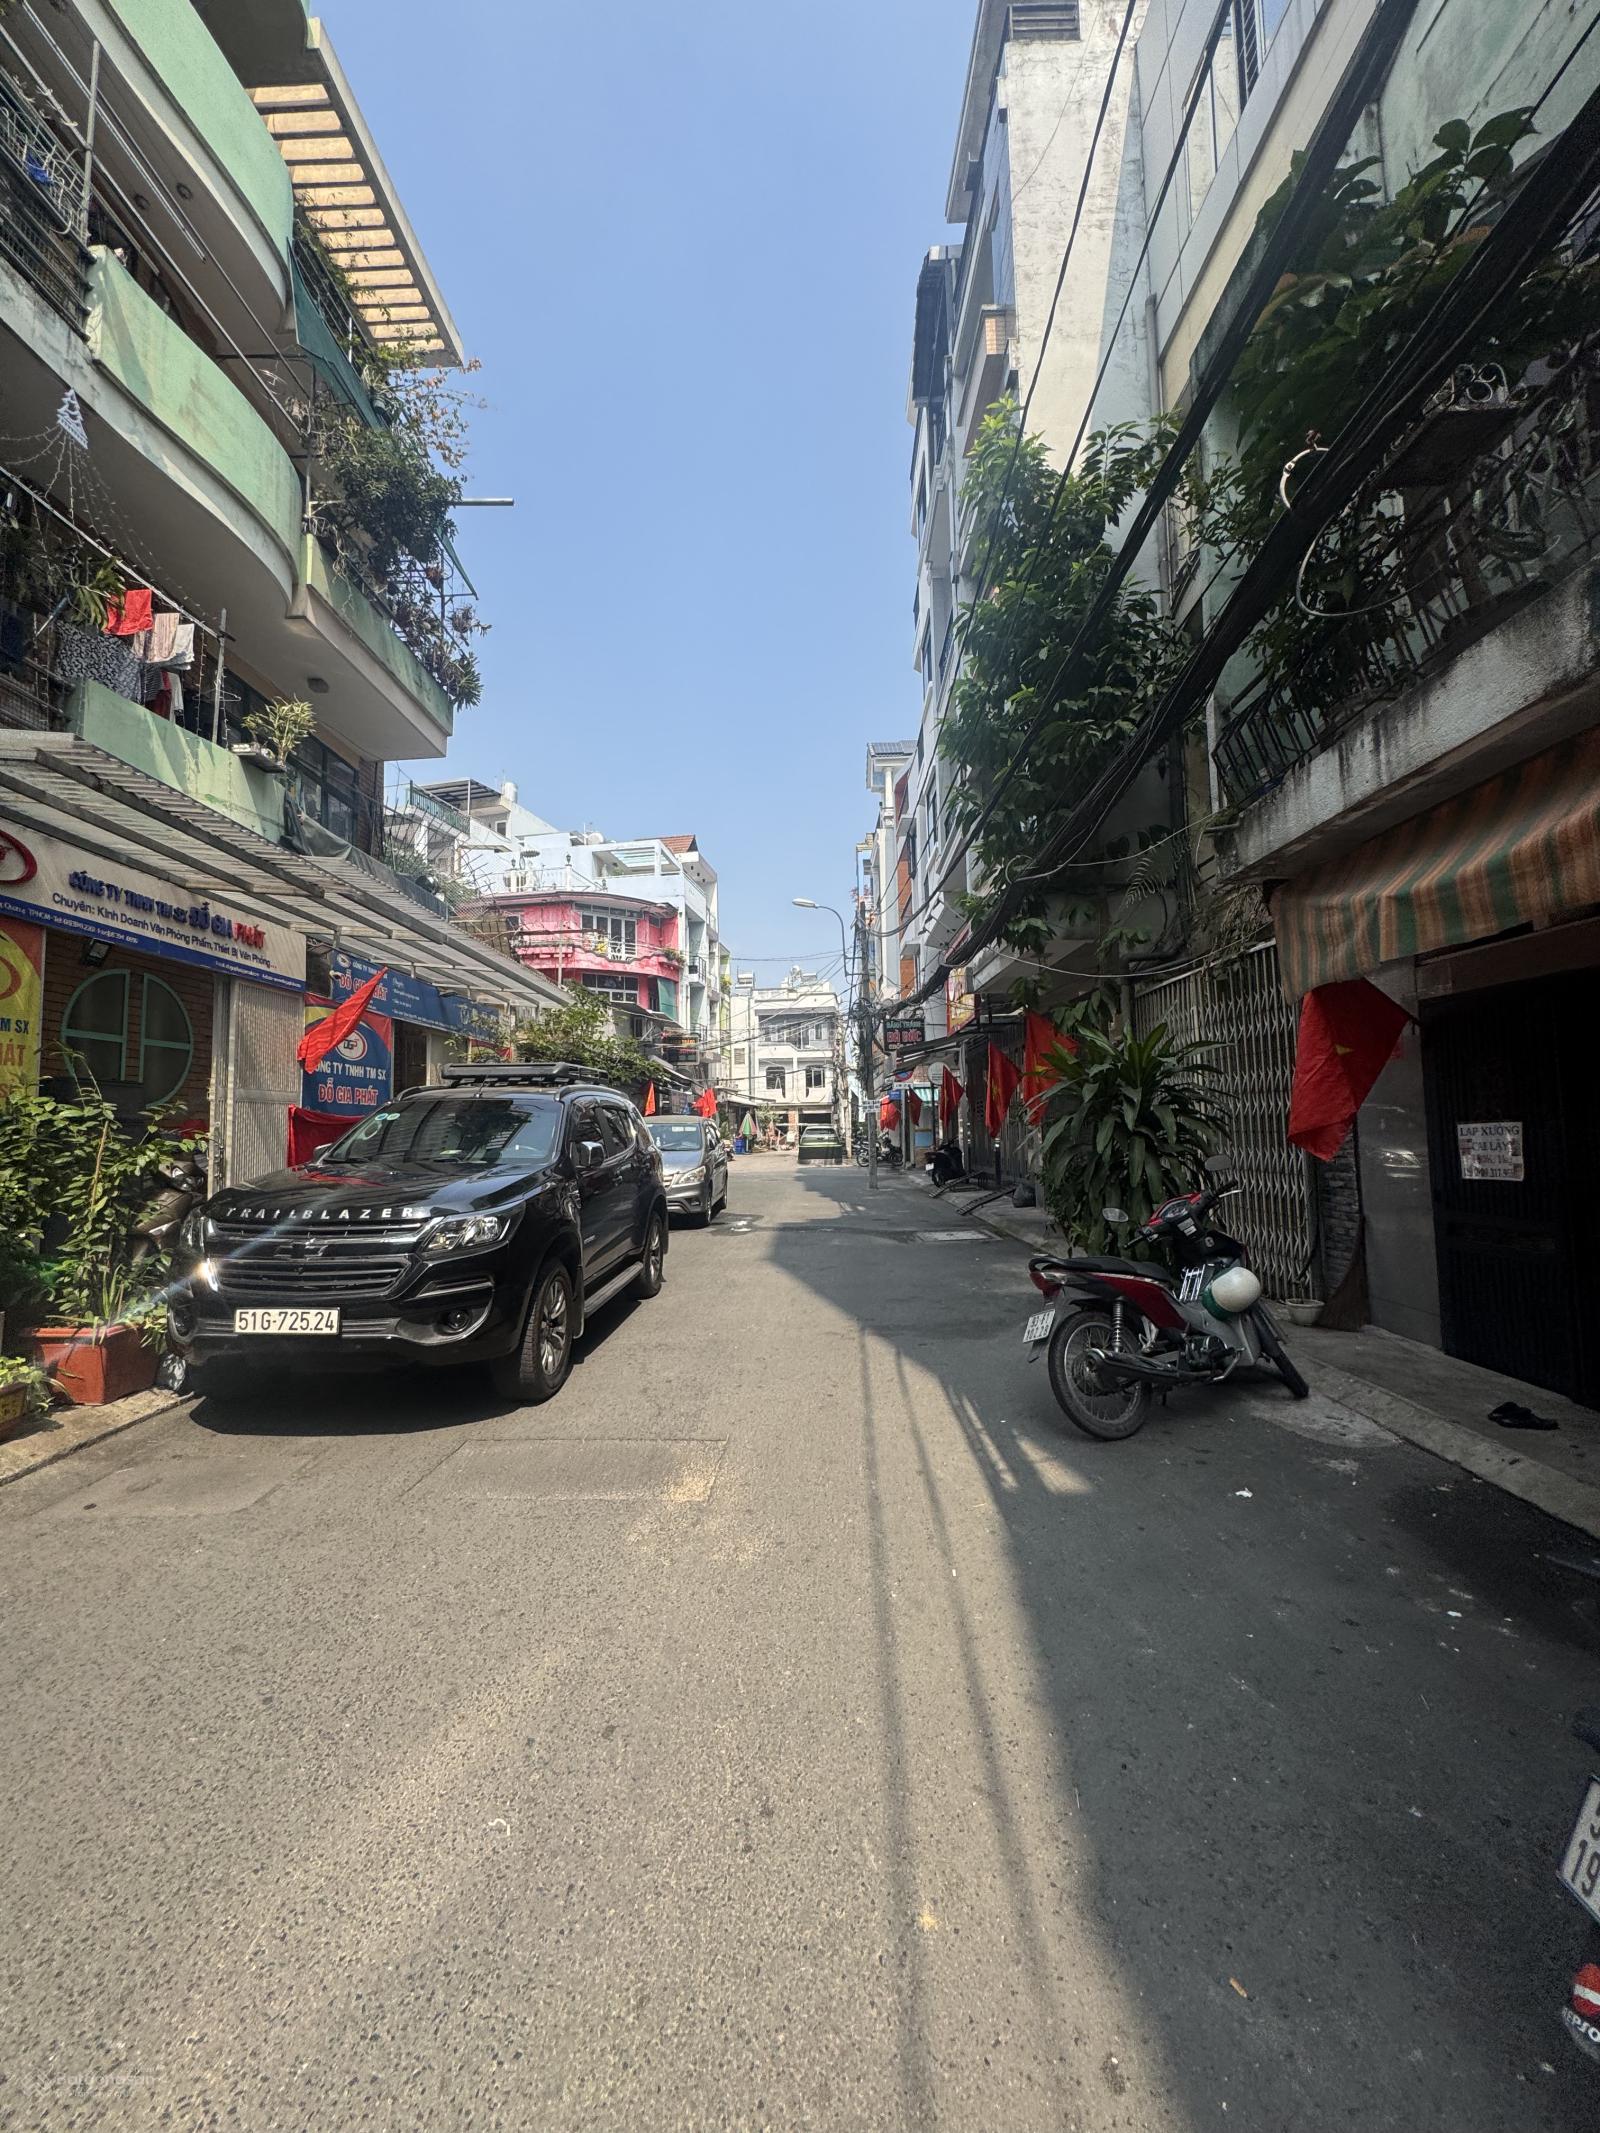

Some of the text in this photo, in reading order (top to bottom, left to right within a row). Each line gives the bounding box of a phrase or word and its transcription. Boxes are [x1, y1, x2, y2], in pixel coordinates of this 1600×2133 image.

[120, 912, 149, 931] Doanh
[15, 1019, 29, 1034] SX
[332, 1062, 343, 1075] TY
[344, 1063, 364, 1078] TNHH
[365, 1066, 376, 1079] TM
[377, 1069, 387, 1081] SX
[318, 1077, 379, 1106] ĐỖ GIA PHÁT
[225, 1207, 414, 1220] TRAILBLAZER
[238, 1311, 335, 1332] 51G-725.24
